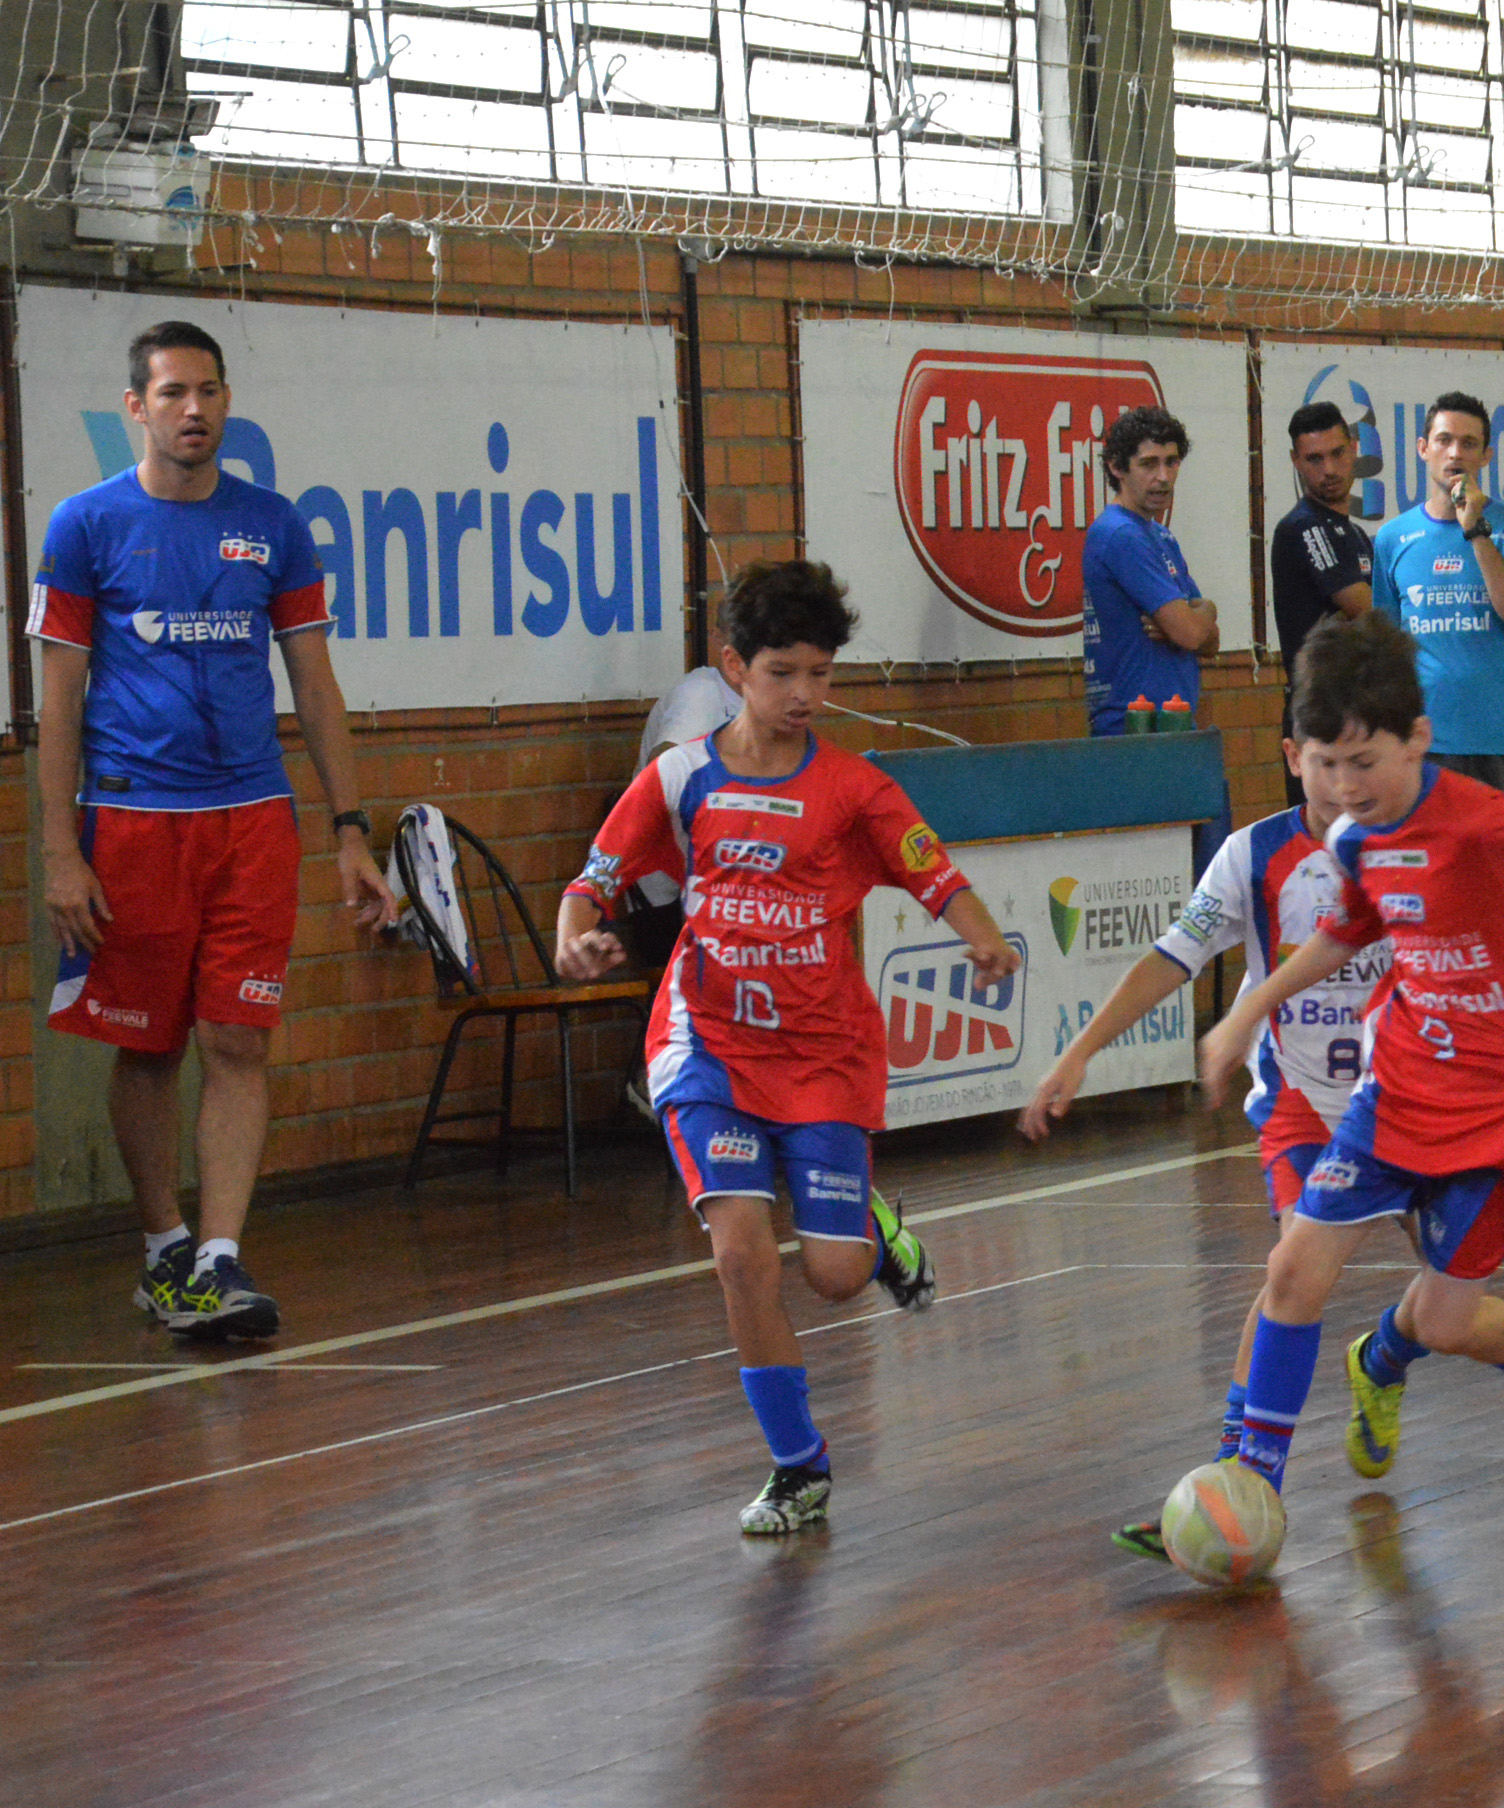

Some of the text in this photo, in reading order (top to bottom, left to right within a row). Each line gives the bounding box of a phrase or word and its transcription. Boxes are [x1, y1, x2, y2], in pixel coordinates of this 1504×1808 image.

[919, 396, 1131, 530] Fritz Fri
[1427, 591, 1490, 606] FEEVALE
[168, 610, 254, 621] UNIVERSIDADE
[1408, 611, 1490, 636] Banrisul
[168, 621, 252, 643] FEEVALE
[711, 882, 827, 905] UNIVERSIDADE
[1083, 875, 1181, 903] UNIVERSIDADE
[710, 895, 828, 929] FEEVALE
[1327, 1038, 1361, 1081] 8
